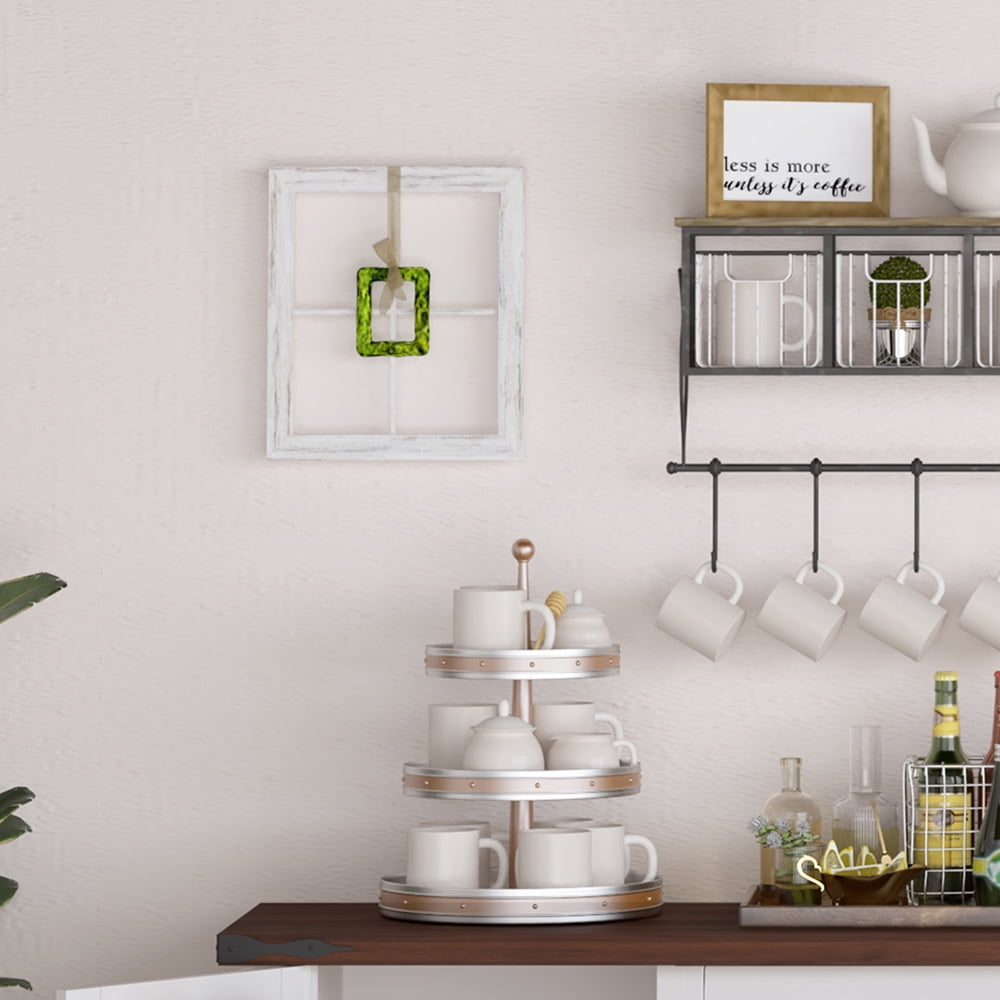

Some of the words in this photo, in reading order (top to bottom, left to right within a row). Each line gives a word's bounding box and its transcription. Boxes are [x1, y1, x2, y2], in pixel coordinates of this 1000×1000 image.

[724, 156, 757, 172] less
[765, 159, 779, 172] is
[787, 161, 830, 173] more
[724, 176, 776, 195] unless
[782, 177, 808, 196] it's
[813, 177, 866, 197] coffee
